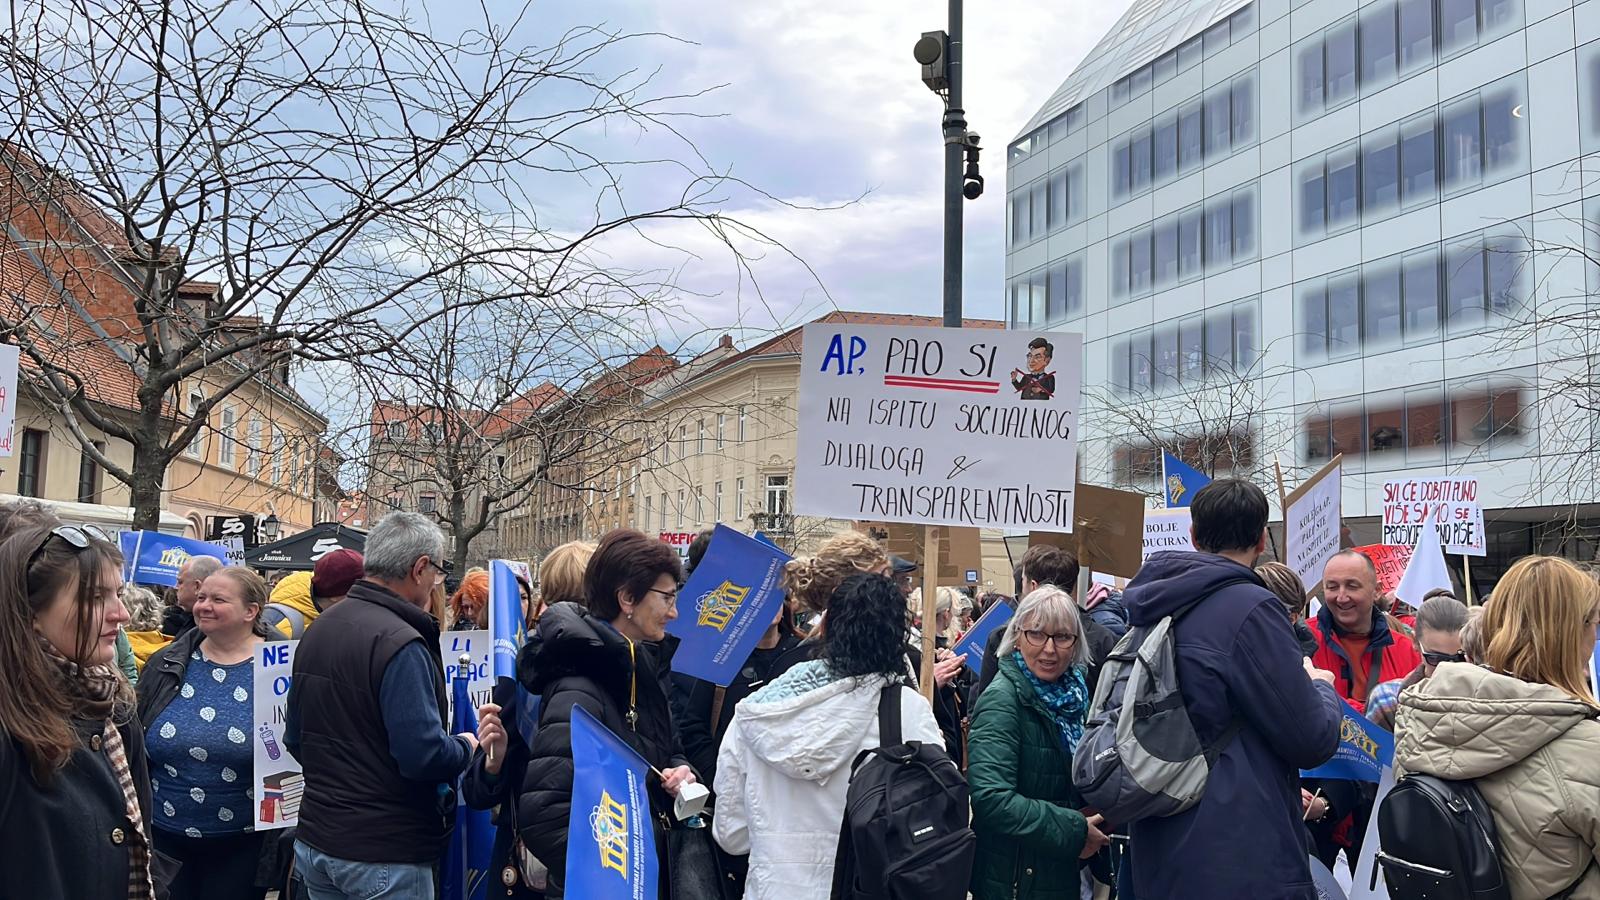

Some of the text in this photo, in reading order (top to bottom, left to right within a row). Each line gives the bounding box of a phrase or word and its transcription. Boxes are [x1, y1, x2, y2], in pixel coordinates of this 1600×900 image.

[820, 334, 998, 378] AP, PAO SI
[826, 396, 1072, 440] NA ISPITU SOCIJALNOG
[821, 440, 924, 476] DIJALOGA
[1384, 483, 1400, 502] SVI
[1421, 480, 1452, 501] DOBITI
[1452, 480, 1477, 501] PUNO
[852, 483, 1072, 528] TRANSPARENTNOSTI
[1455, 508, 1469, 519] SE
[1146, 523, 1178, 533] BOLJE
[1454, 520, 1474, 545] PIŠE
[452, 637, 470, 652] LI
[263, 645, 288, 667] NE
[273, 676, 292, 696] O
